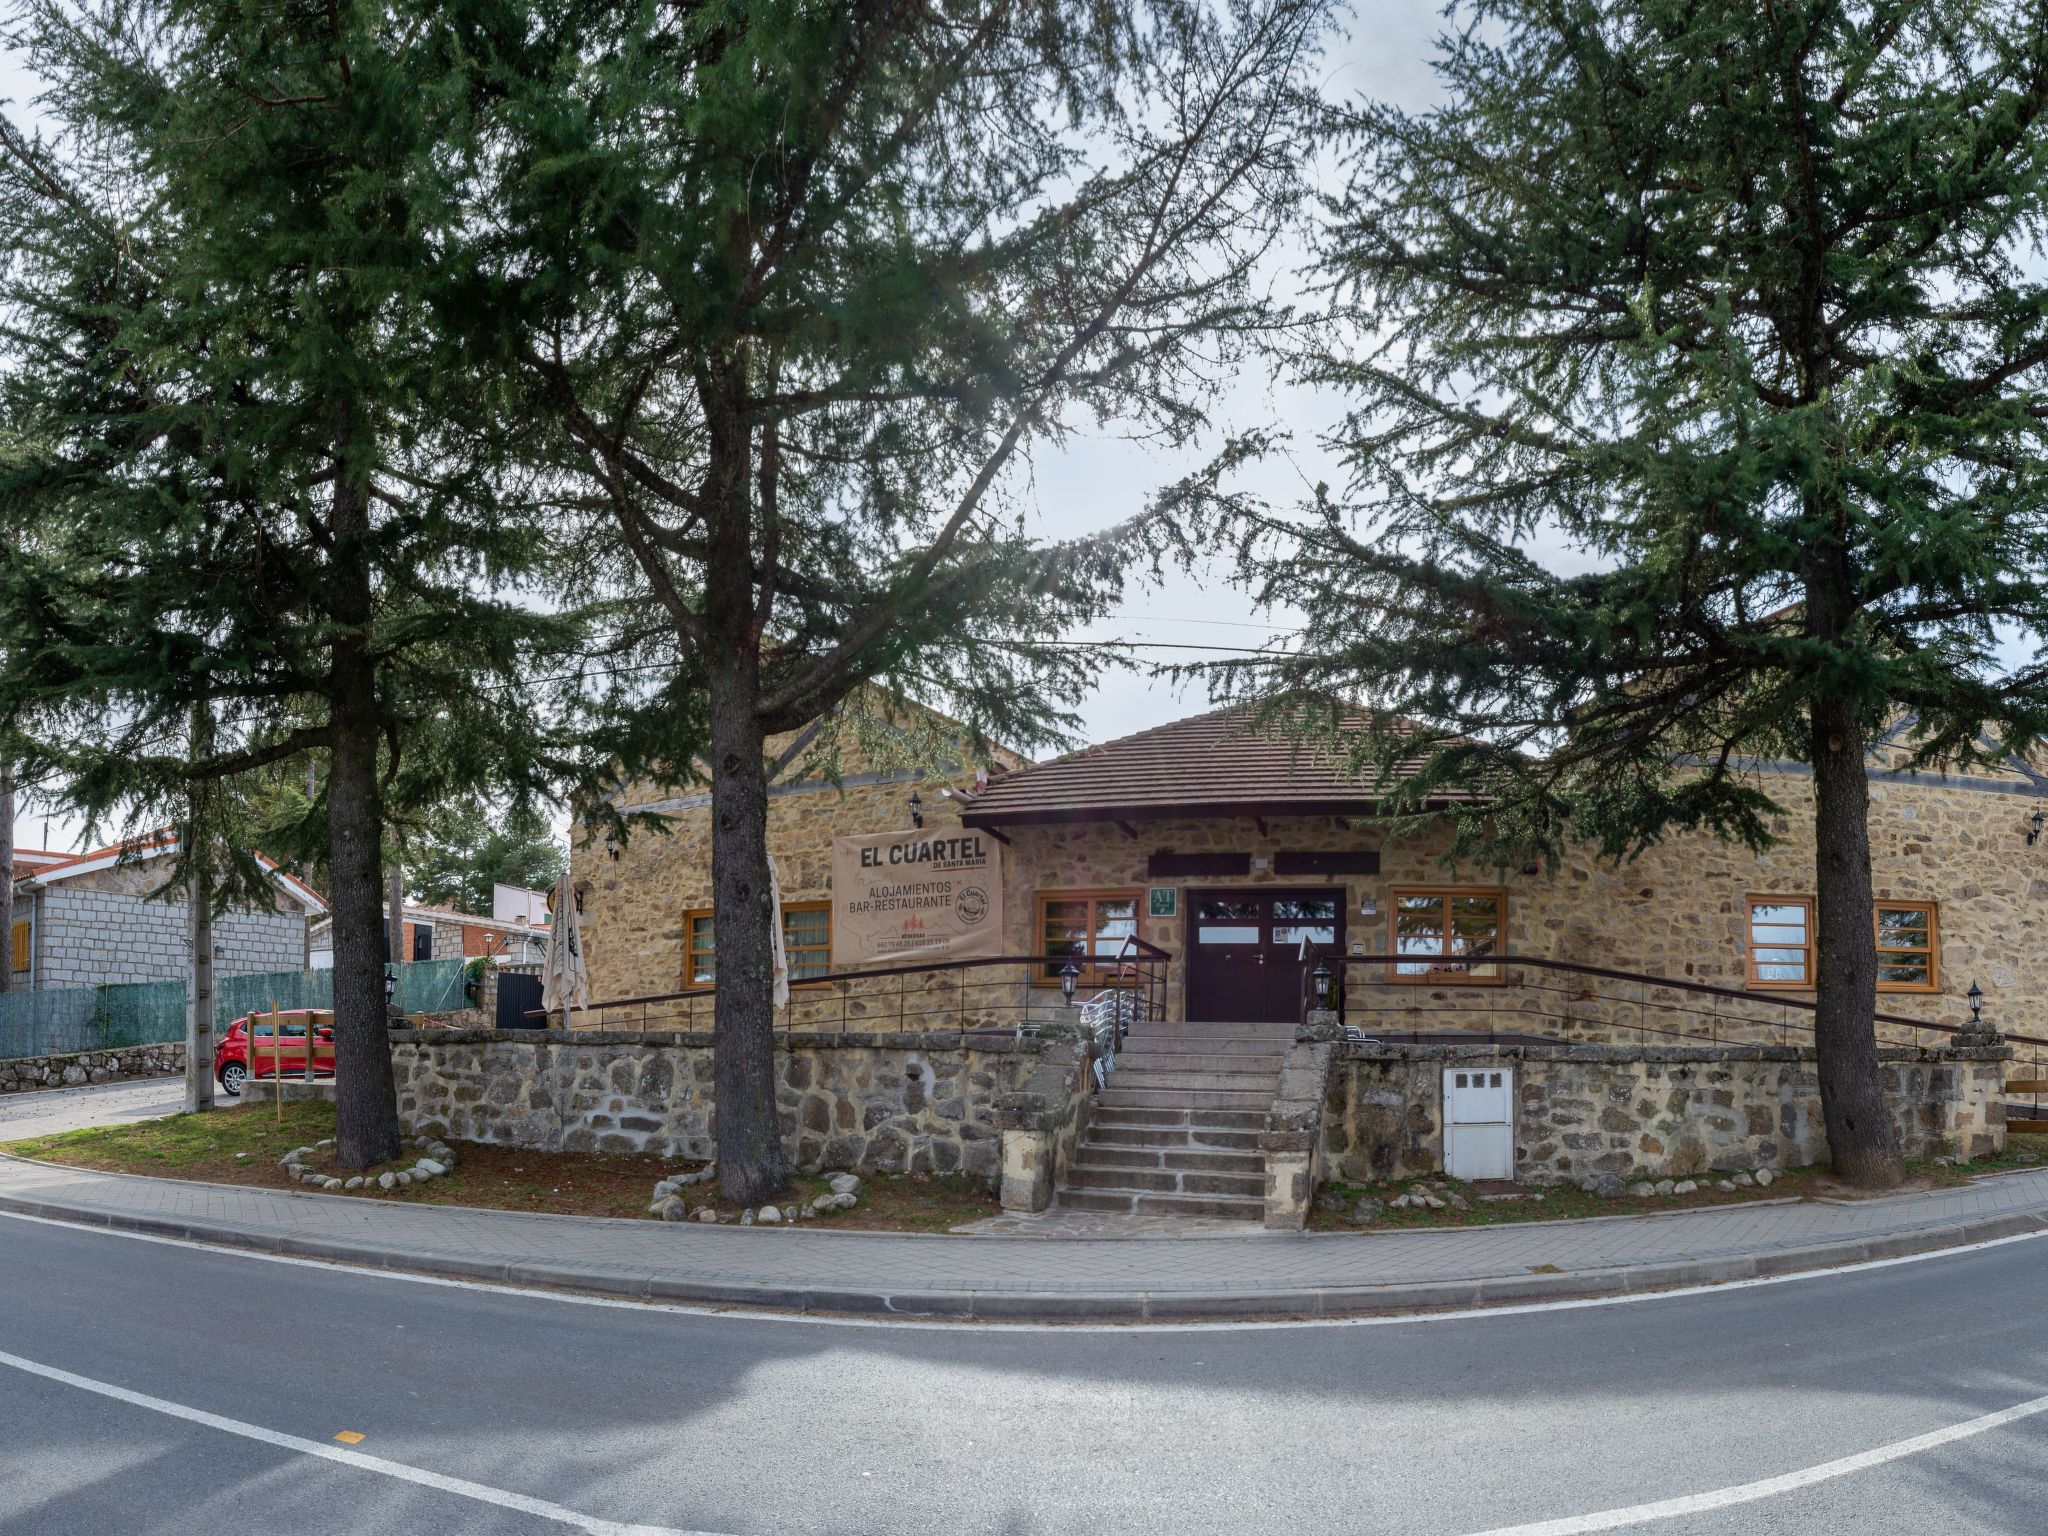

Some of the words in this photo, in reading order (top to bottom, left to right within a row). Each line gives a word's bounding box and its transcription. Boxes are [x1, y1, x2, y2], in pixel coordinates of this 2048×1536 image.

[861, 847, 883, 867] EL
[889, 837, 986, 865] CUARTEL
[943, 860, 963, 868] SANTA
[965, 858, 986, 866] MARÍA
[869, 882, 952, 898] ALOJAMIENTOS
[960, 893, 966, 901] El
[966, 889, 987, 905] Cuartel
[1153, 890, 1173, 902] AT
[850, 895, 952, 913] BAR-RESTAURANTE
